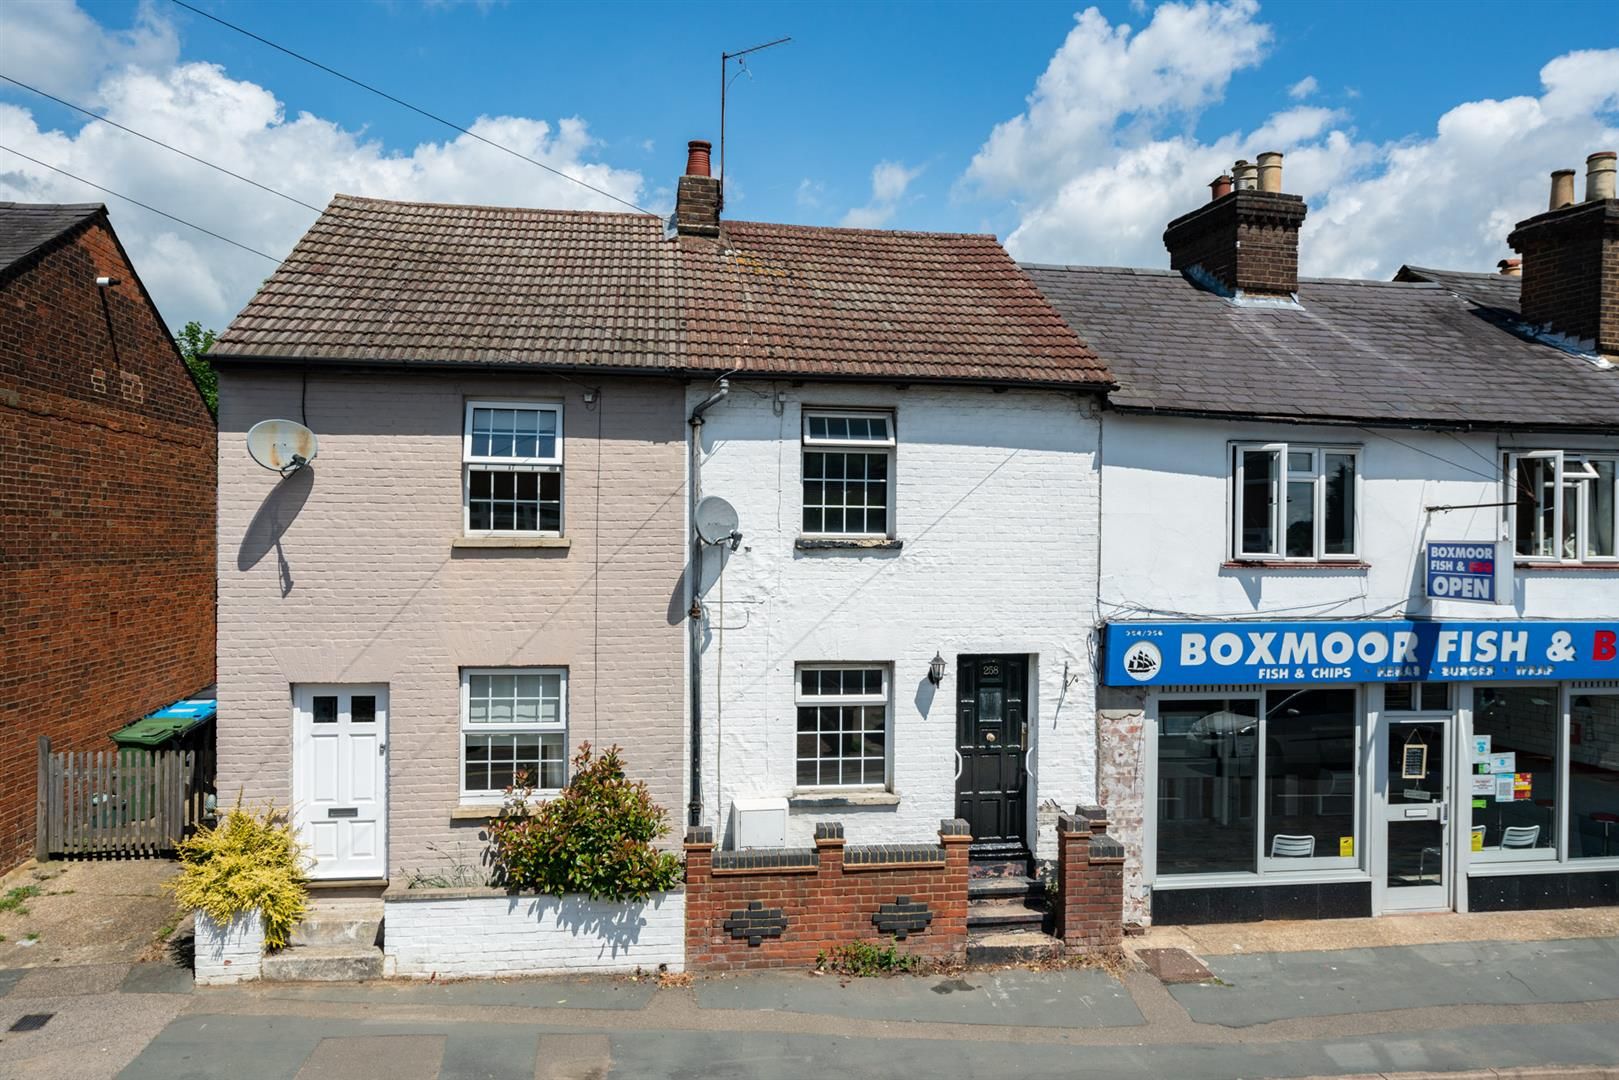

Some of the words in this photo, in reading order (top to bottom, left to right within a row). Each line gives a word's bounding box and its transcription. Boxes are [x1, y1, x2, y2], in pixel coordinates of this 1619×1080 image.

[1430, 546, 1493, 560] BOXMOOR
[1430, 560, 1453, 572] FISH
[1456, 561, 1465, 572] &
[1432, 576, 1490, 599] OPEN
[1179, 630, 1419, 666] BOXMOOR
[1437, 630, 1528, 663] FISH
[1546, 630, 1577, 662] &
[983, 665, 999, 675] 258
[1258, 668, 1289, 680] FISH
[1294, 668, 1305, 679] &
[1311, 667, 1352, 679] CHIPS
